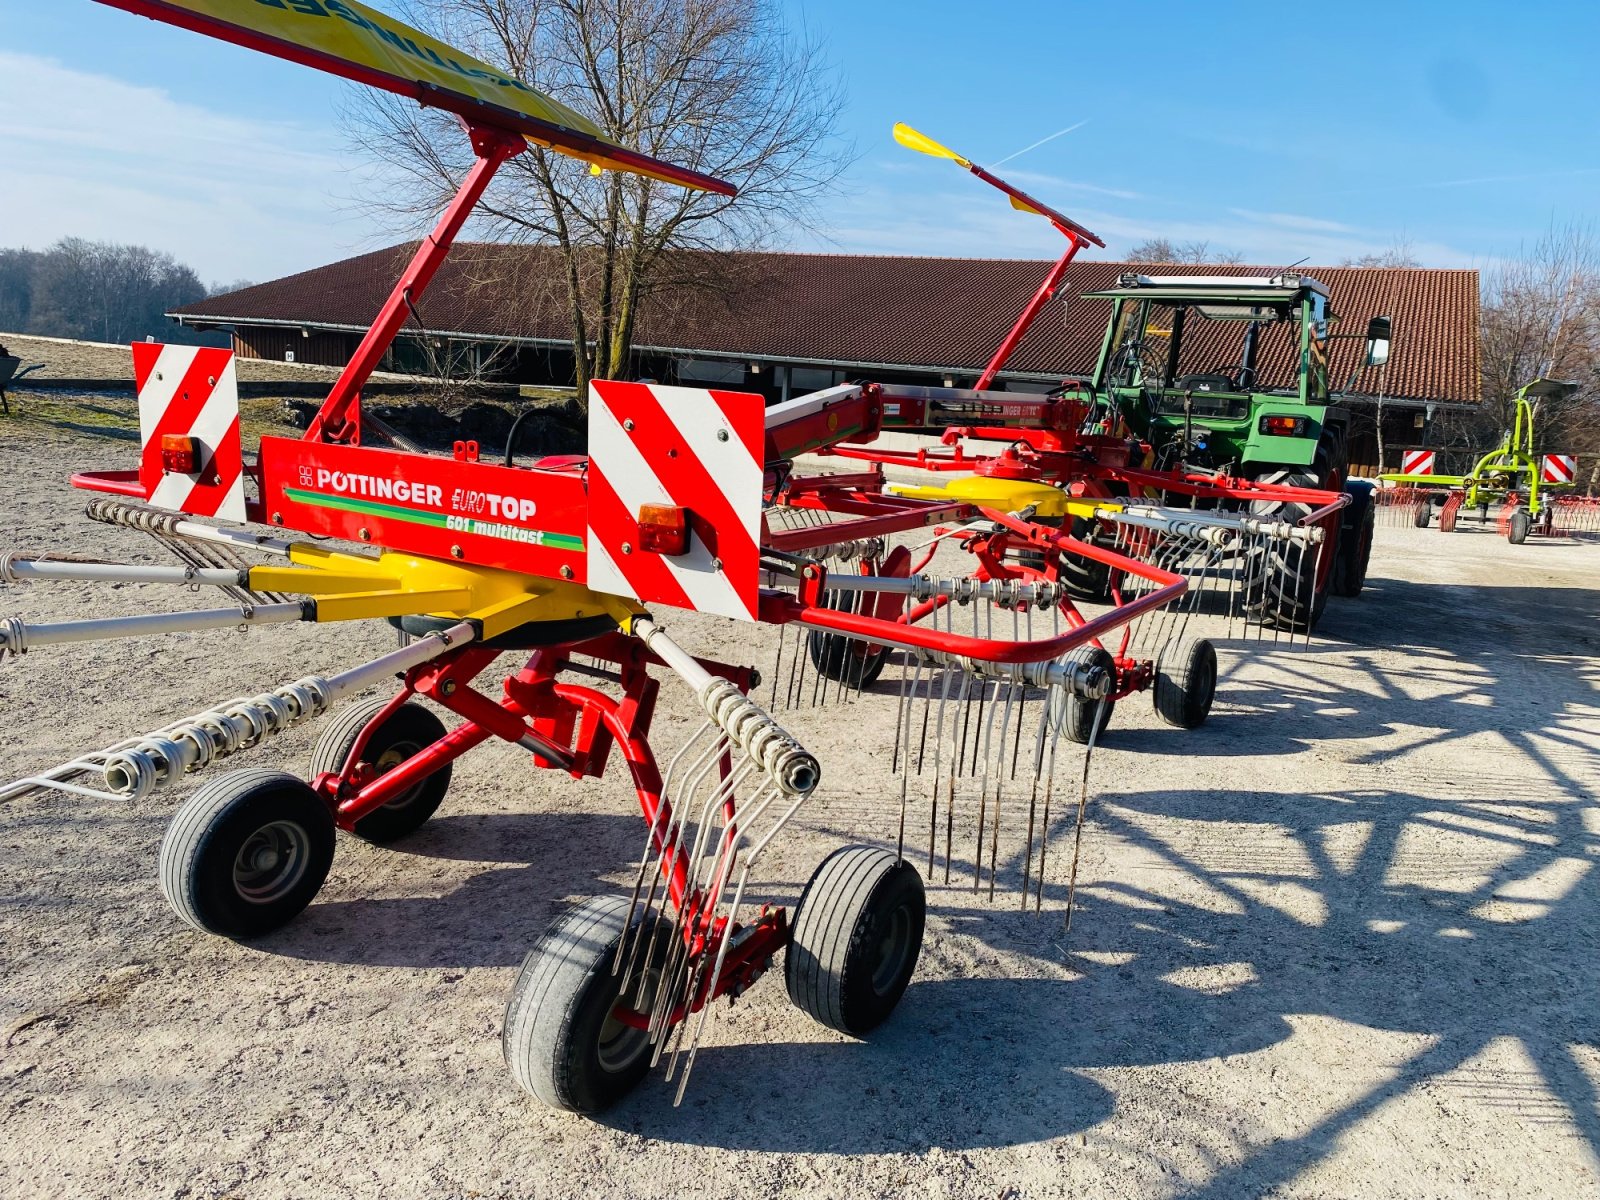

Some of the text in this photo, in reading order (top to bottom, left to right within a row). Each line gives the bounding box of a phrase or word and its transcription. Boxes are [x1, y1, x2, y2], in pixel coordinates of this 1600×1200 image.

[317, 468, 443, 507] PÖTTINGER
[446, 515, 545, 545] 601 multitast
